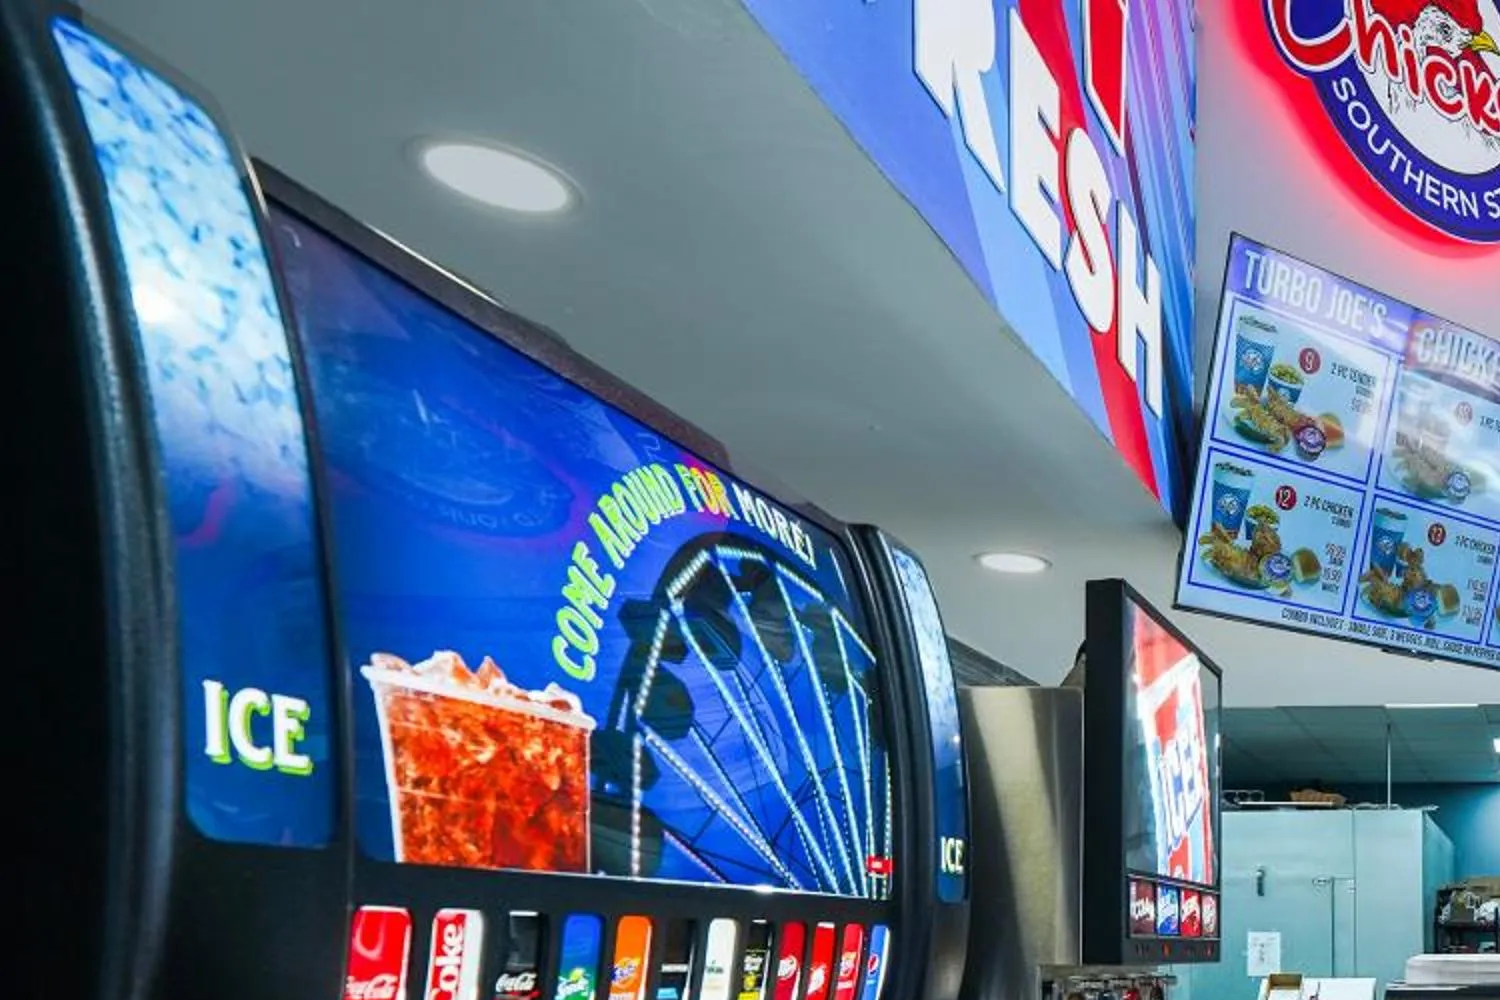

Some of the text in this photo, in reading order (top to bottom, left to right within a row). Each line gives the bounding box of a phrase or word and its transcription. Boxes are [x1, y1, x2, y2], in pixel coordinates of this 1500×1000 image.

[1332, 77, 1480, 219] SOUTHERN
[1244, 249, 1322, 314] TURBO
[1325, 283, 1388, 339] JOE'S
[552, 541, 616, 682] COME
[588, 463, 686, 569] AROUND
[674, 463, 731, 519] FOR
[202, 679, 313, 777] ICE
[940, 835, 964, 875] ICE
